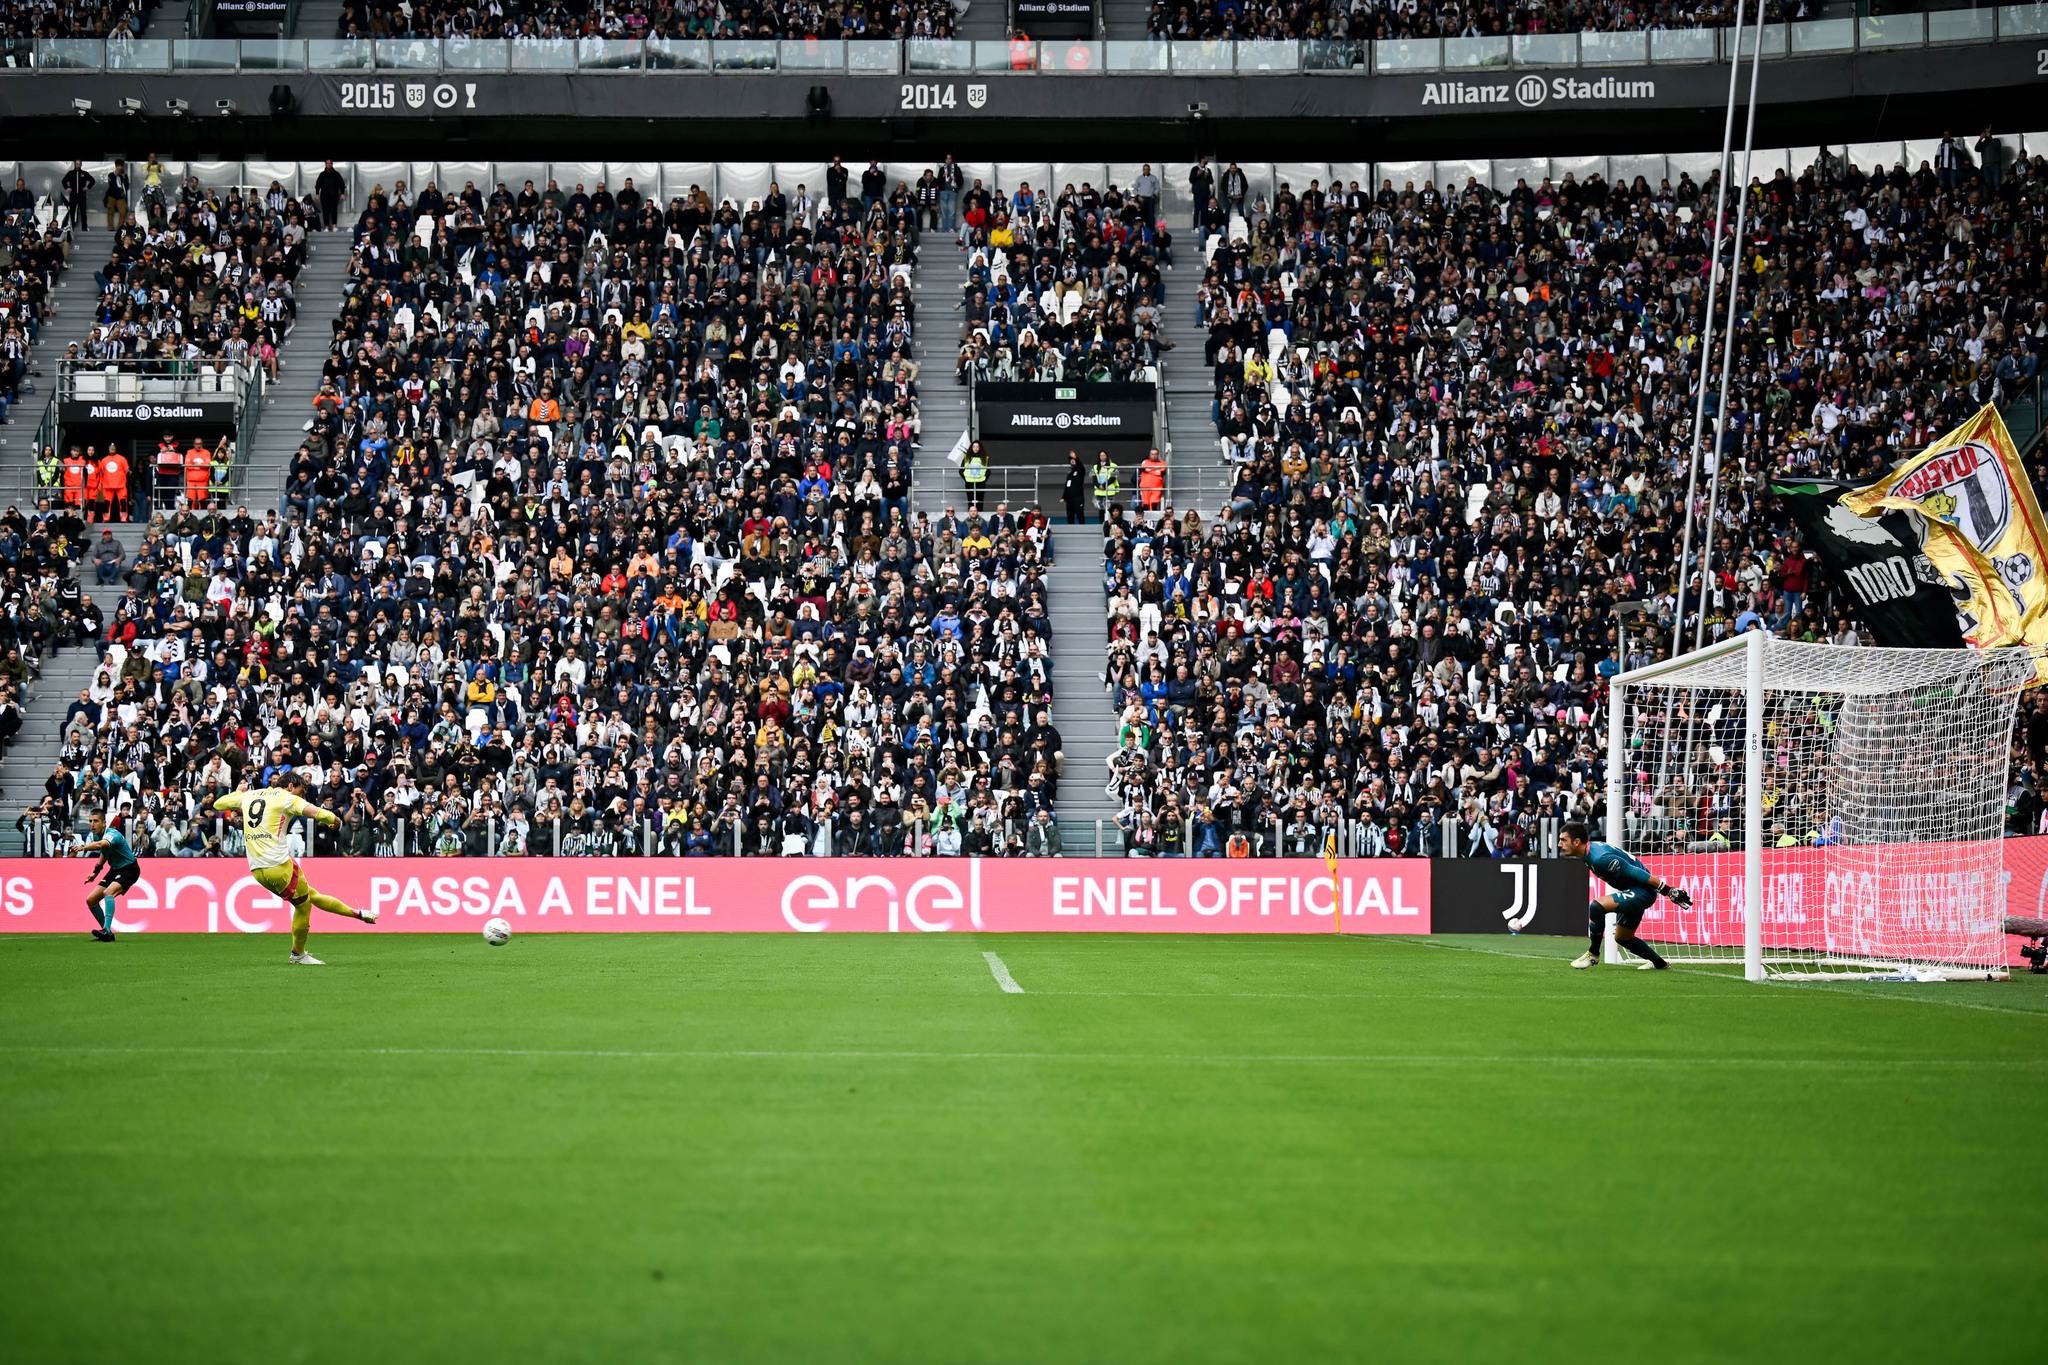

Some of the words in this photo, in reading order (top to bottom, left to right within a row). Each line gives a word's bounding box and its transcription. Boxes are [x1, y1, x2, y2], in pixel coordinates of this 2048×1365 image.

[217, 2, 245, 10] Allianz
[1019, 4, 1046, 12] Allianz
[1058, 4, 1090, 12] Stadium
[341, 83, 395, 109] 2015
[408, 88, 423, 102] 33
[901, 84, 957, 109] 2014
[969, 88, 984, 102] 32
[1421, 81, 1510, 105] Allianz
[1553, 76, 1655, 100] Stadium
[90, 405, 133, 418] Allianz
[153, 405, 203, 418] Stadium
[1011, 414, 1054, 426] Allianz
[1072, 413, 1121, 426] Stadium
[1843, 555, 1916, 606] NORD
[247, 798, 266, 828] 9
[247, 832, 273, 842] Cygames
[0, 876, 34, 916] S
[371, 876, 527, 916] PASSA
[538, 877, 574, 915] A
[586, 877, 712, 915] ENEL
[782, 859, 983, 933] enel
[1053, 877, 1177, 916] ENEL
[1188, 876, 1419, 916] OFFICIAL
[1777, 873, 1807, 924] ENEL
